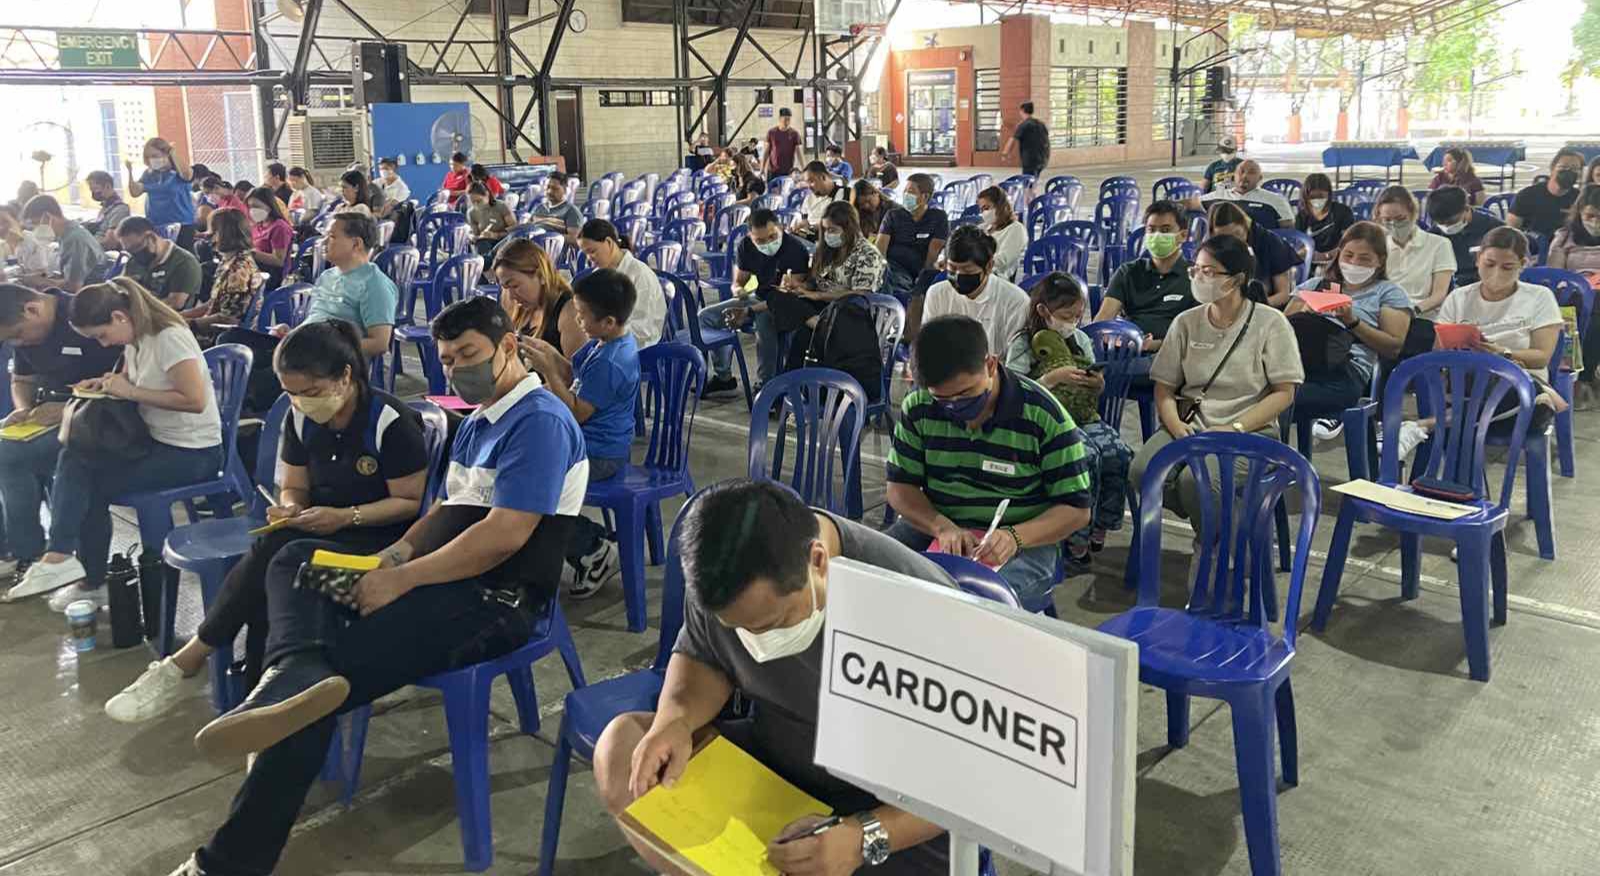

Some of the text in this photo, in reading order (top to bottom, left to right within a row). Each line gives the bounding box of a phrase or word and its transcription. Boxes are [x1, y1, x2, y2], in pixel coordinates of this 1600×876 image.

[59, 35, 136, 49] EMERGENCY
[87, 51, 113, 66] EXIT
[841, 652, 1066, 765] CARDONER
